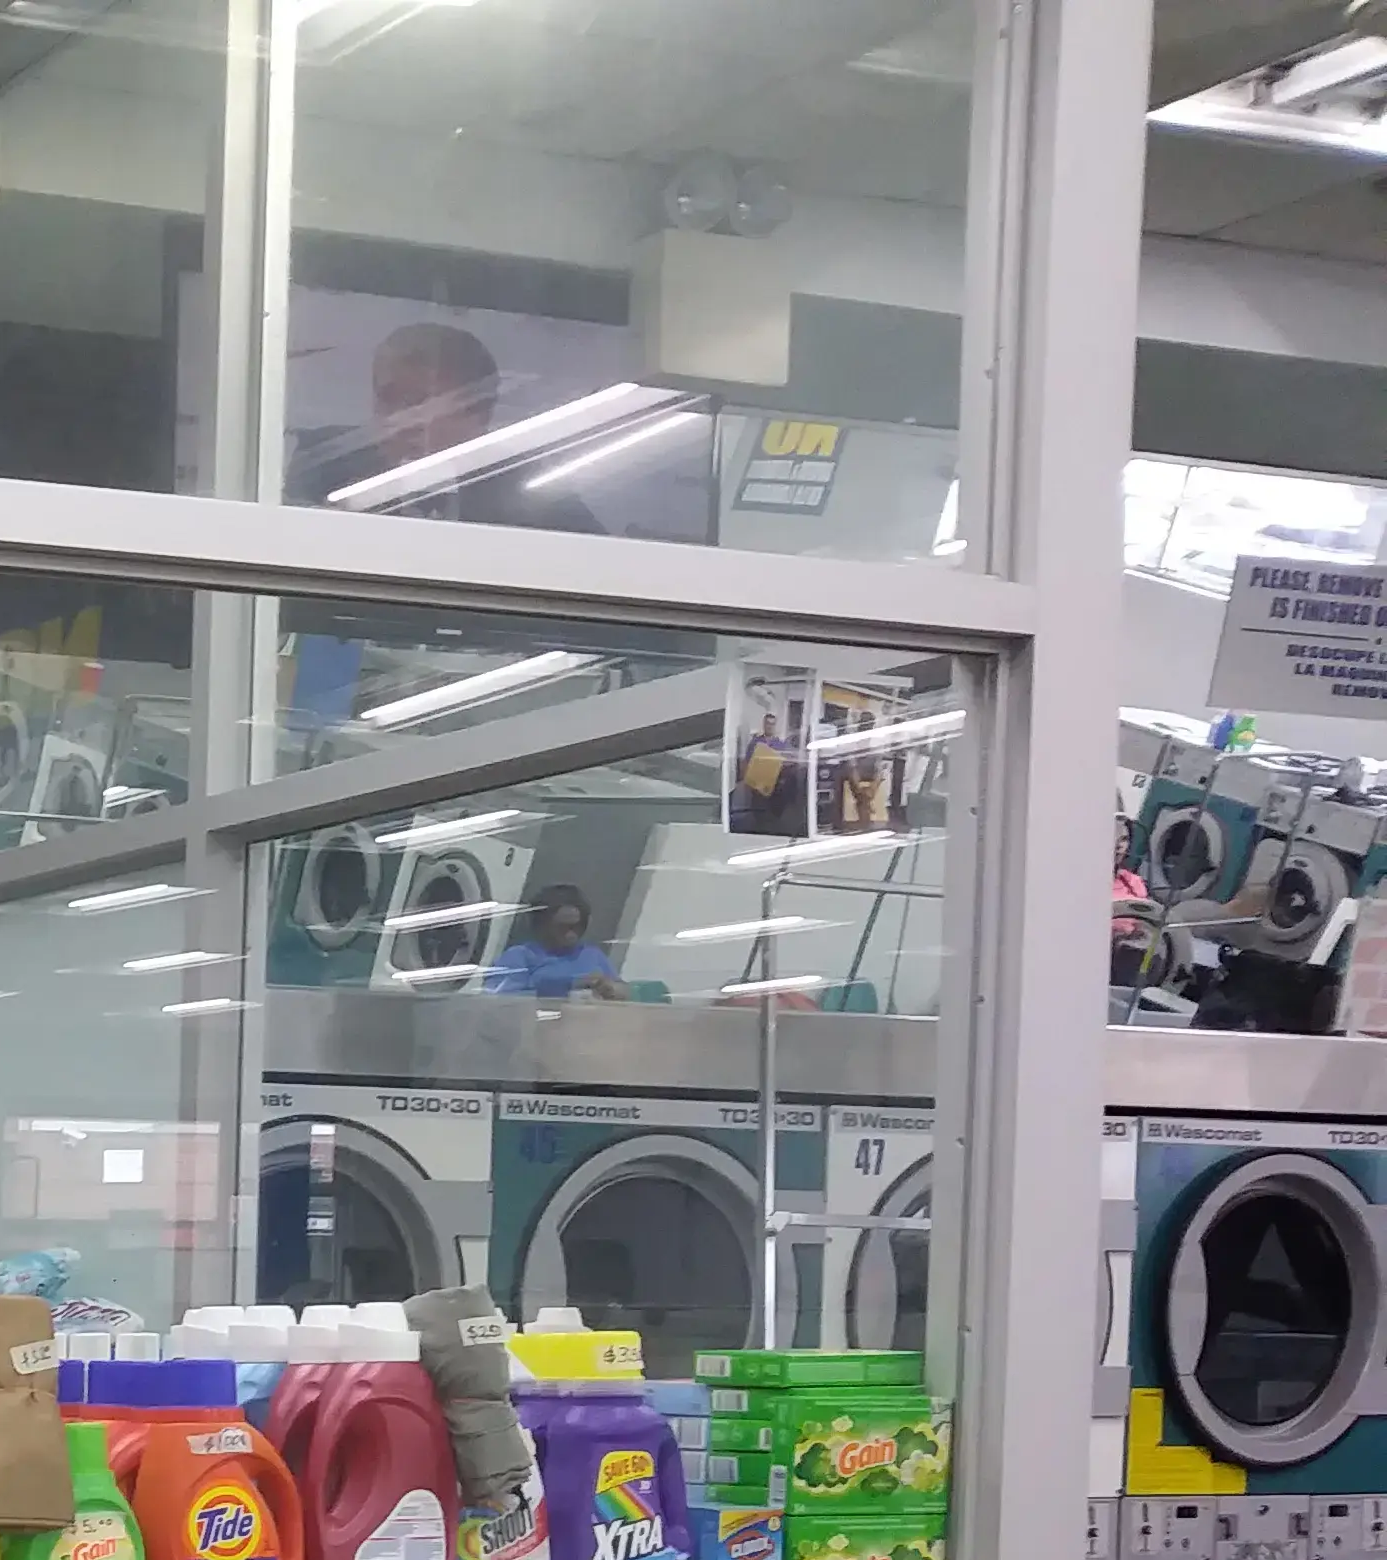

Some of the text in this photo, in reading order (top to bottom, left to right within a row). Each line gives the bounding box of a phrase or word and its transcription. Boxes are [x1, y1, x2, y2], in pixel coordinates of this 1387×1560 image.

[527, 1100, 641, 1120] Wascomat
[1165, 1123, 1263, 1141] Wascomat
[854, 1138, 886, 1176] 47
[836, 1438, 898, 1476] Gain
[195, 1501, 255, 1553] Tide
